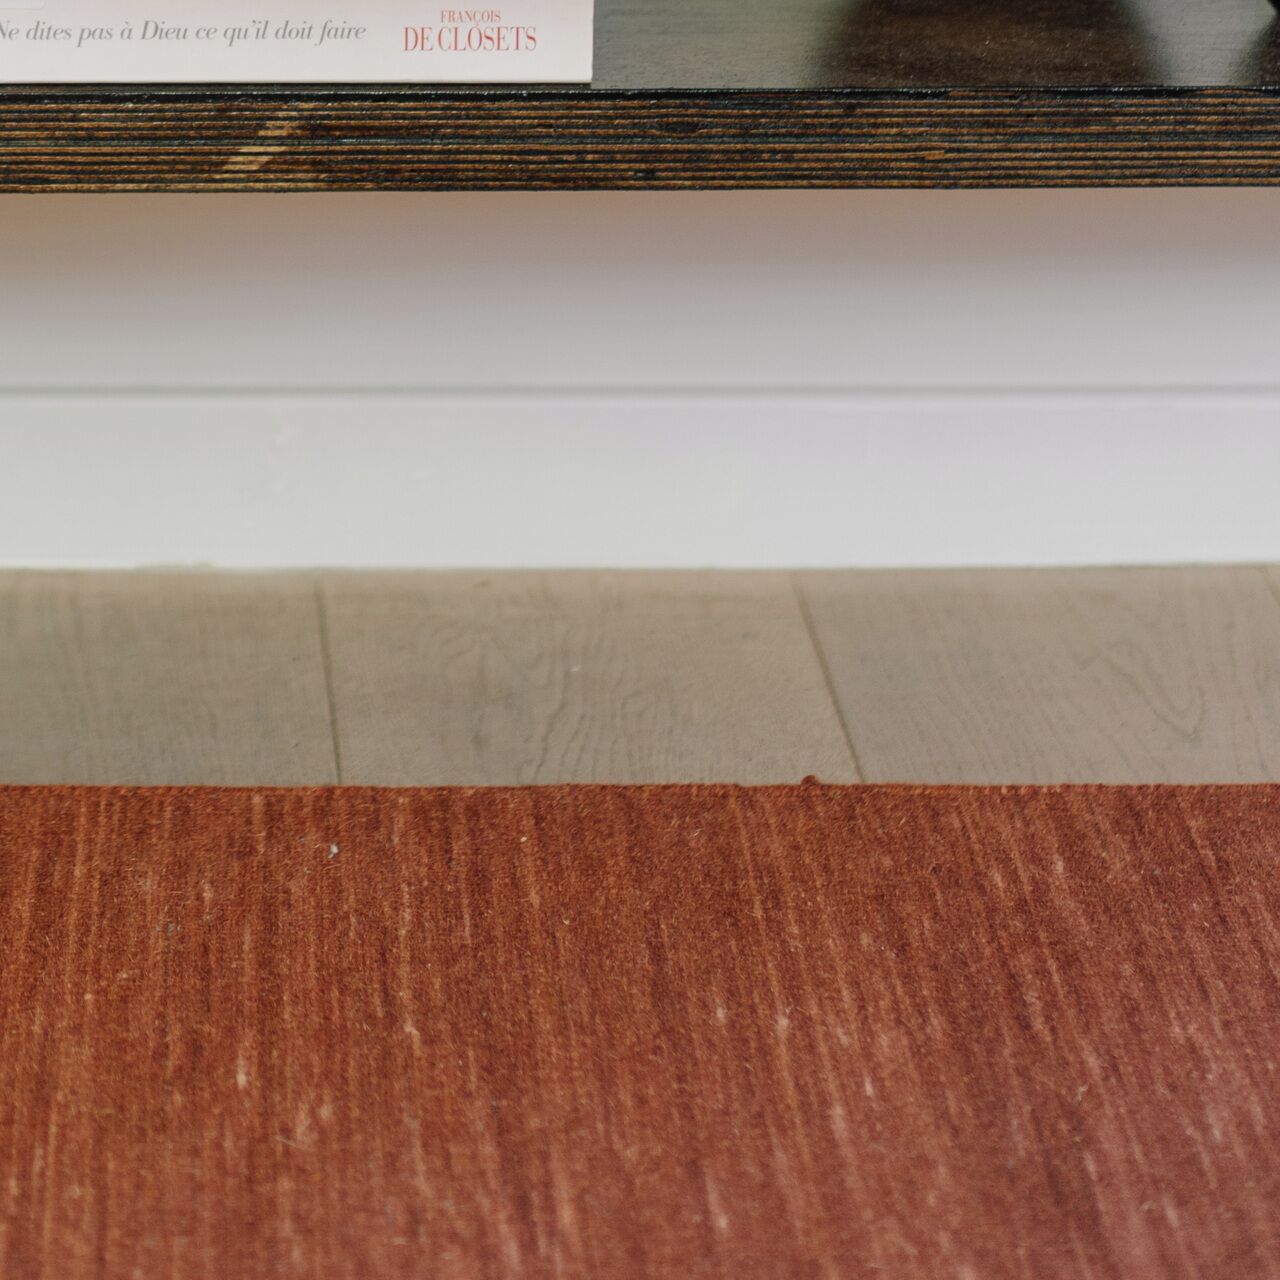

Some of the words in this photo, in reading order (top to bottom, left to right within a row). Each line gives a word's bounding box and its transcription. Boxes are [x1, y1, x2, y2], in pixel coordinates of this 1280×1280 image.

[440, 9, 502, 26] FRANÇOIS
[25, 19, 72, 40] dites
[77, 27, 114, 48] pas
[120, 21, 134, 40] à
[141, 19, 189, 40] Dieu
[194, 27, 218, 40] ce
[223, 19, 270, 47] qu'il
[274, 20, 314, 40] doit
[314, 19, 367, 47] faire
[403, 26, 434, 52] DE
[437, 26, 538, 52] CLOSETS
